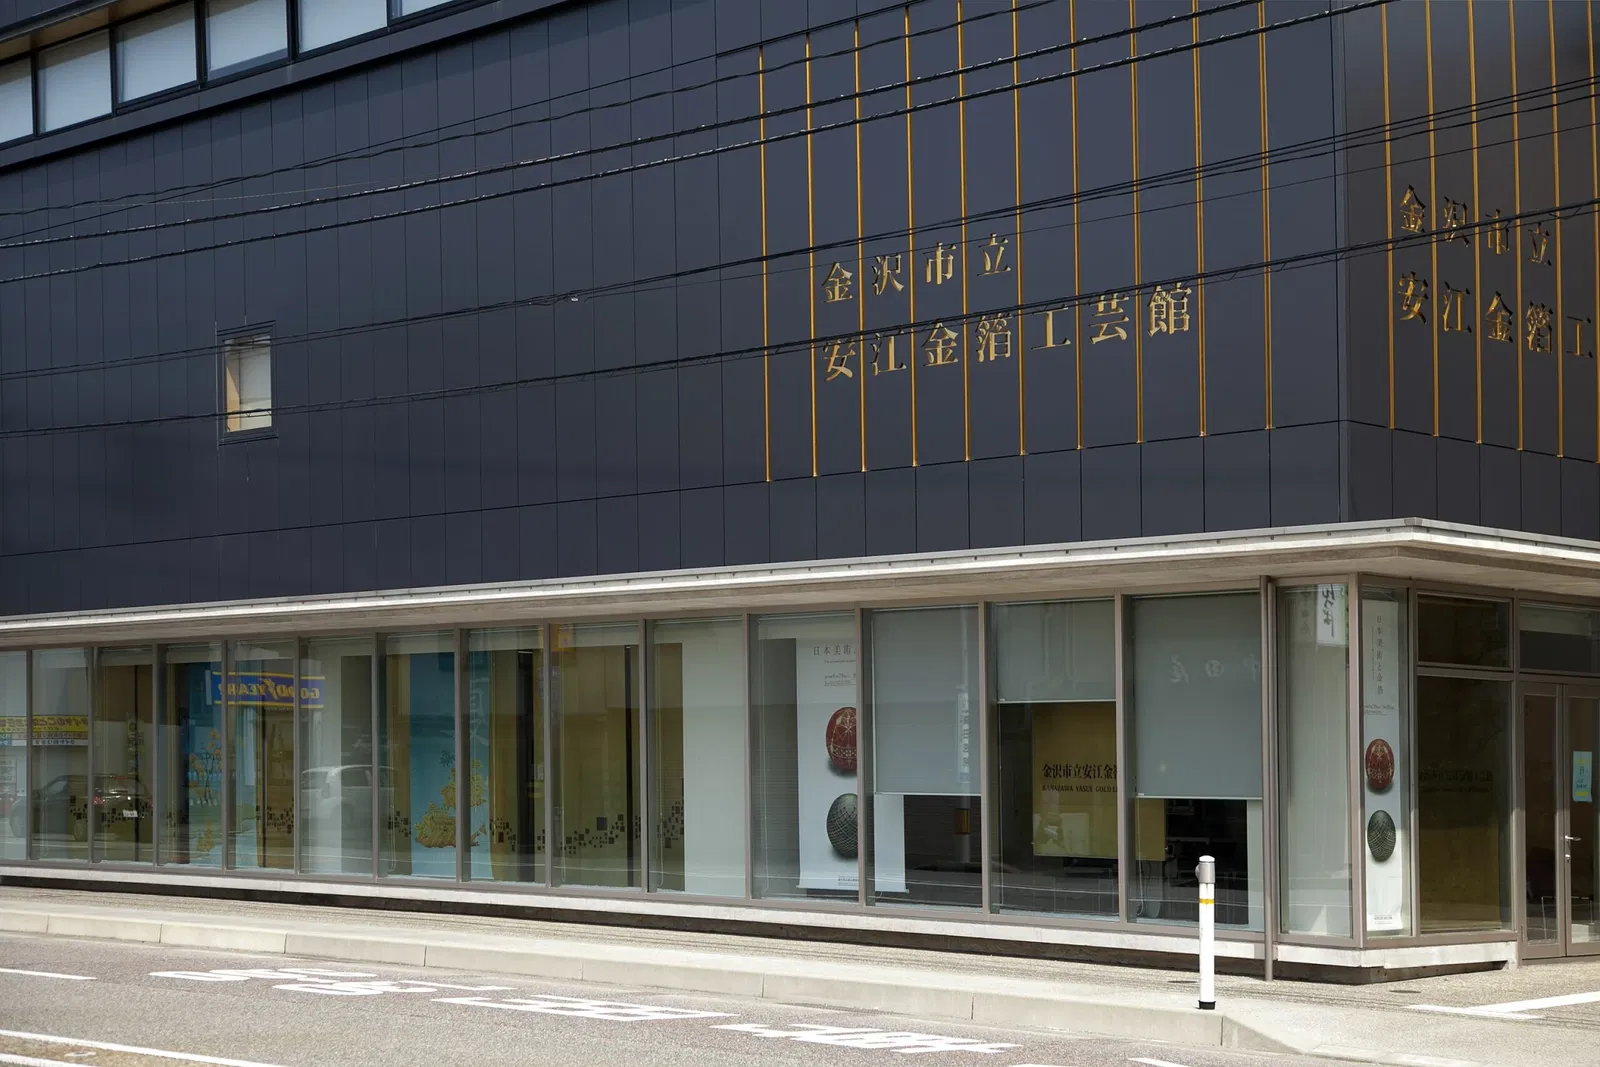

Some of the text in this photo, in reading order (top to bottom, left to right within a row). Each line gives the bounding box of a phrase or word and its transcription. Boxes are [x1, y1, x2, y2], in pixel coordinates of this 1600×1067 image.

[1399, 184, 1552, 266] 金沢市立
[821, 233, 1012, 304] 金沢市立
[823, 281, 1192, 382] 安江金箔工芸館
[813, 644, 857, 656] 日本美術
